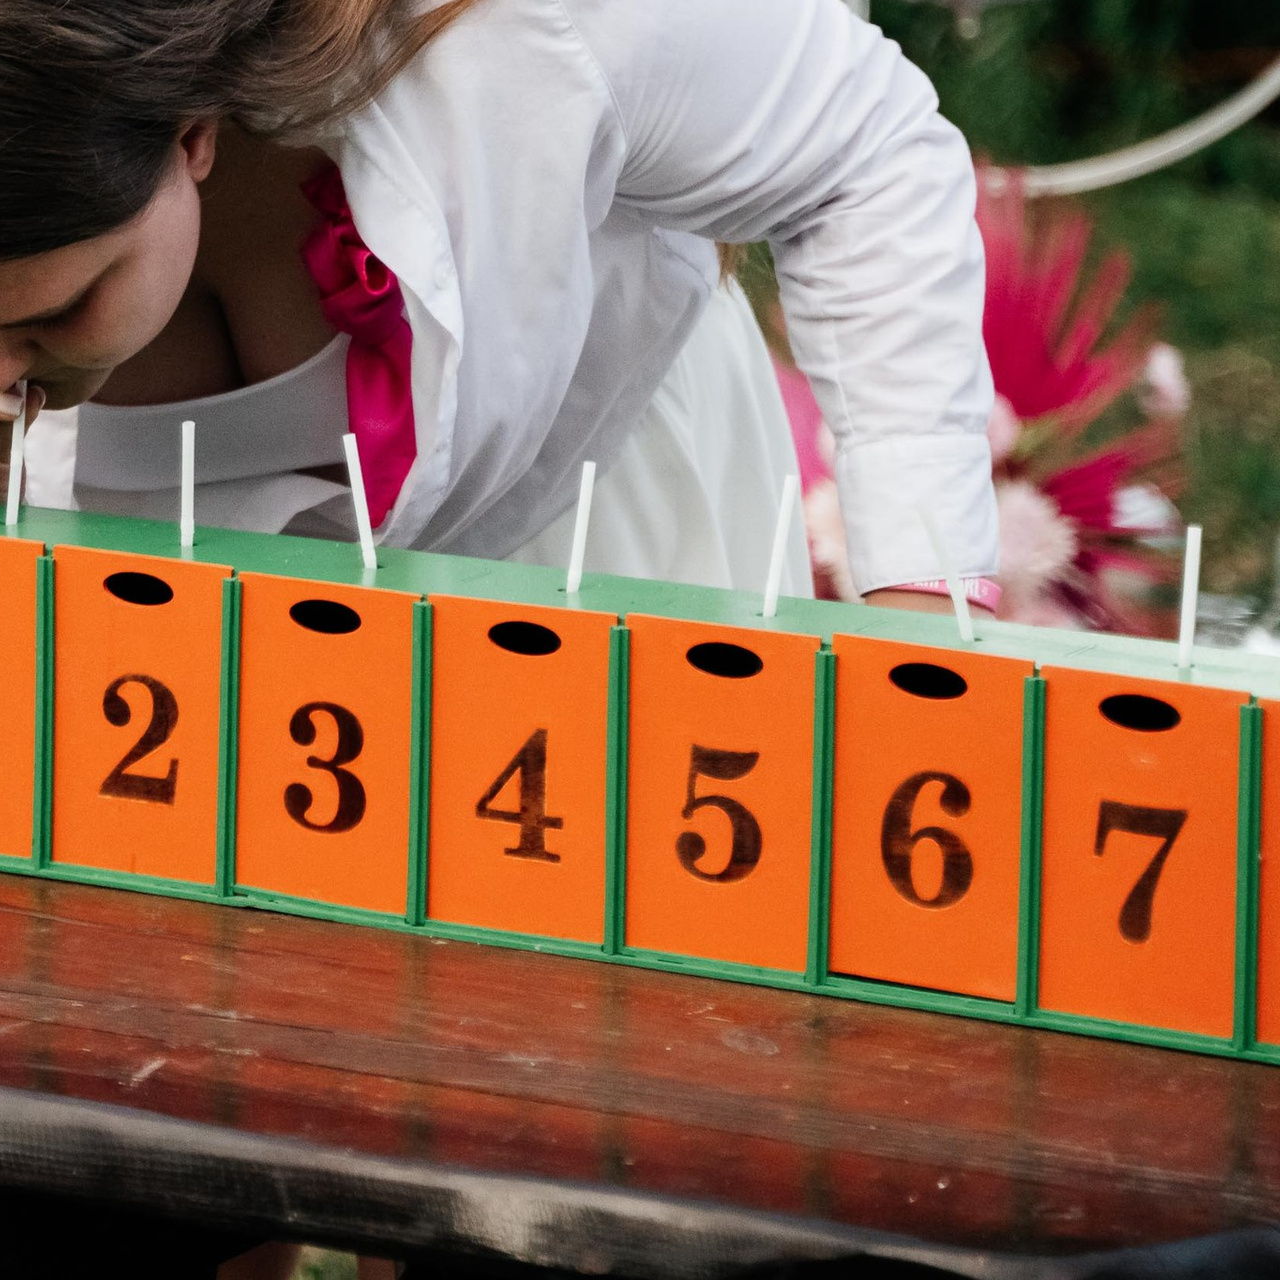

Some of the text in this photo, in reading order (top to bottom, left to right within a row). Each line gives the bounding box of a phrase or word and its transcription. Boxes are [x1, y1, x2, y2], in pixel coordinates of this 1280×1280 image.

[99, 673, 180, 804] 2
[283, 701, 368, 834] 3
[476, 728, 565, 863] 4
[676, 744, 764, 884] 5
[880, 771, 975, 909] 6
[1095, 799, 1188, 942] 7
